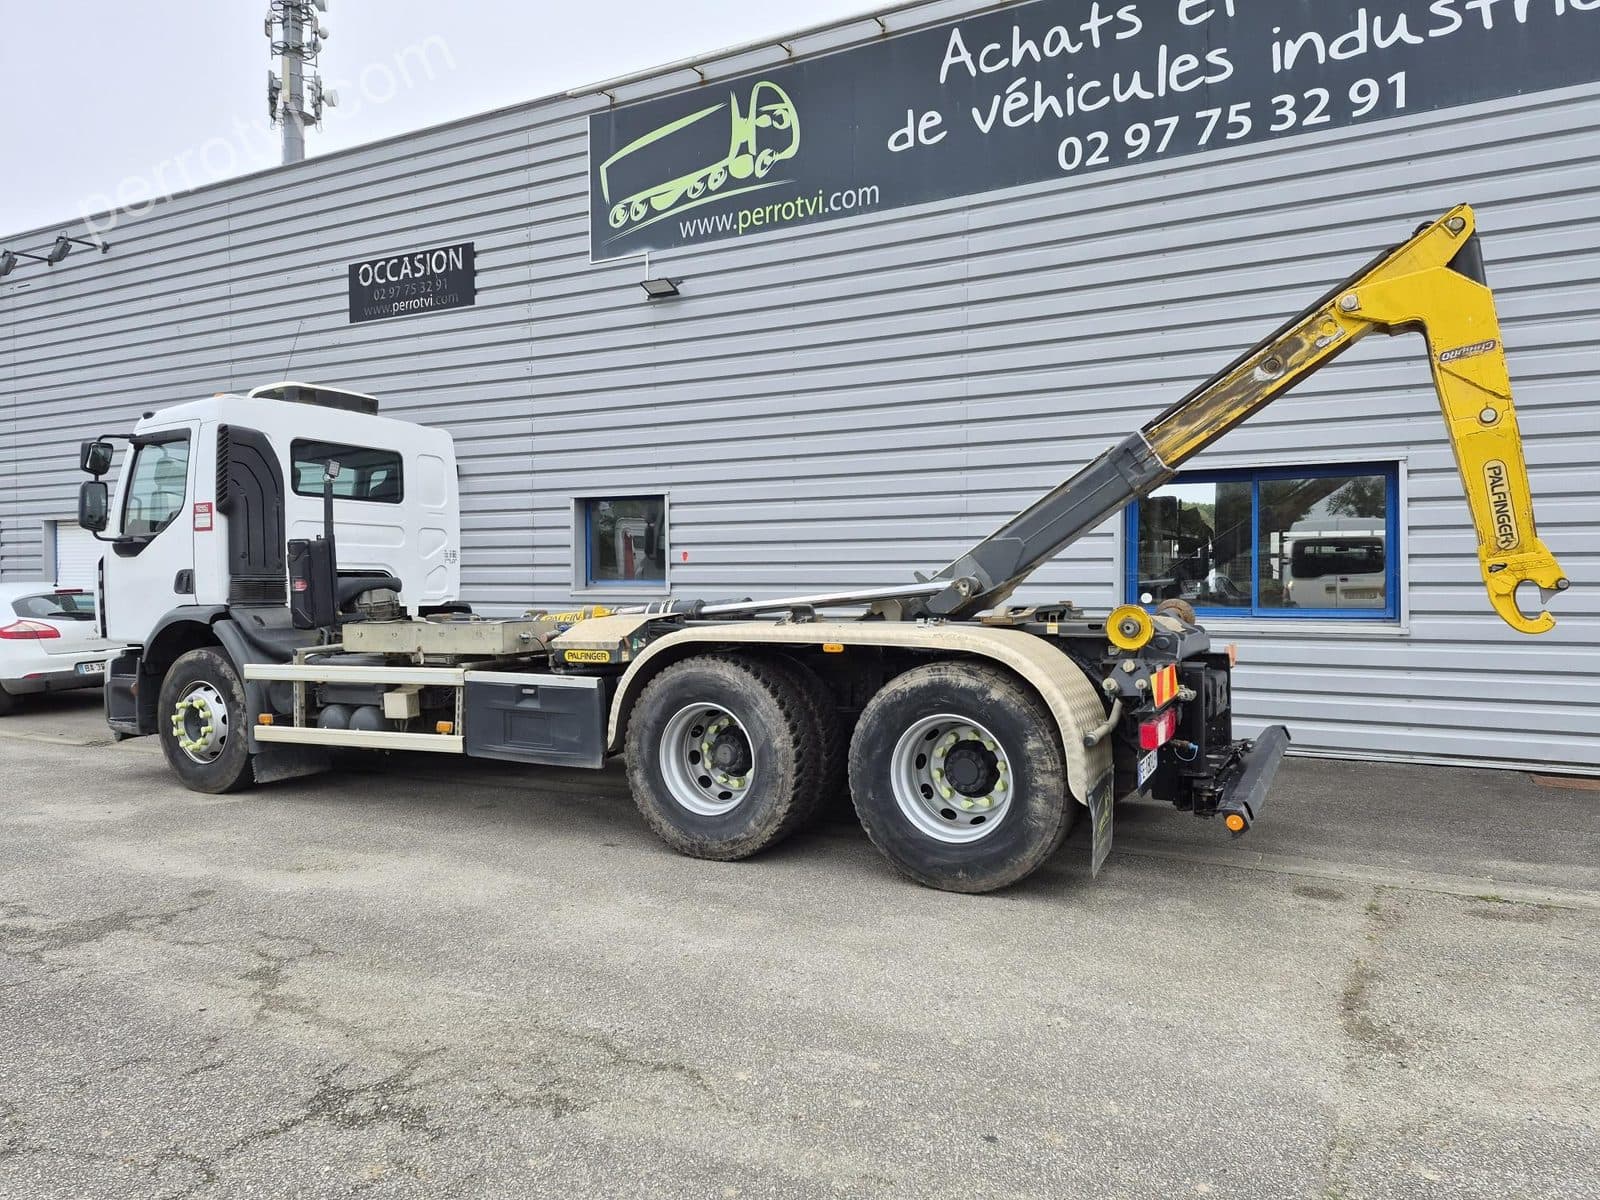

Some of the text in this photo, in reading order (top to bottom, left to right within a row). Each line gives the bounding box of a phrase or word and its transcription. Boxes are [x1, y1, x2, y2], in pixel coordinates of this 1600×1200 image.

[940, 1, 1143, 84] Achats
[887, 0, 1600, 153] de véhicules industr
[1057, 71, 1406, 171] 02 97 75 32 91
[679, 184, 880, 239] www.perrotvi.com
[359, 247, 463, 287] OCCASION
[373, 278, 448, 301] 02 97 75 32 91
[363, 292, 459, 316] www.perrotvi.com
[1487, 465, 1517, 547] PALFINGER
[566, 651, 608, 661] PALFINGER
